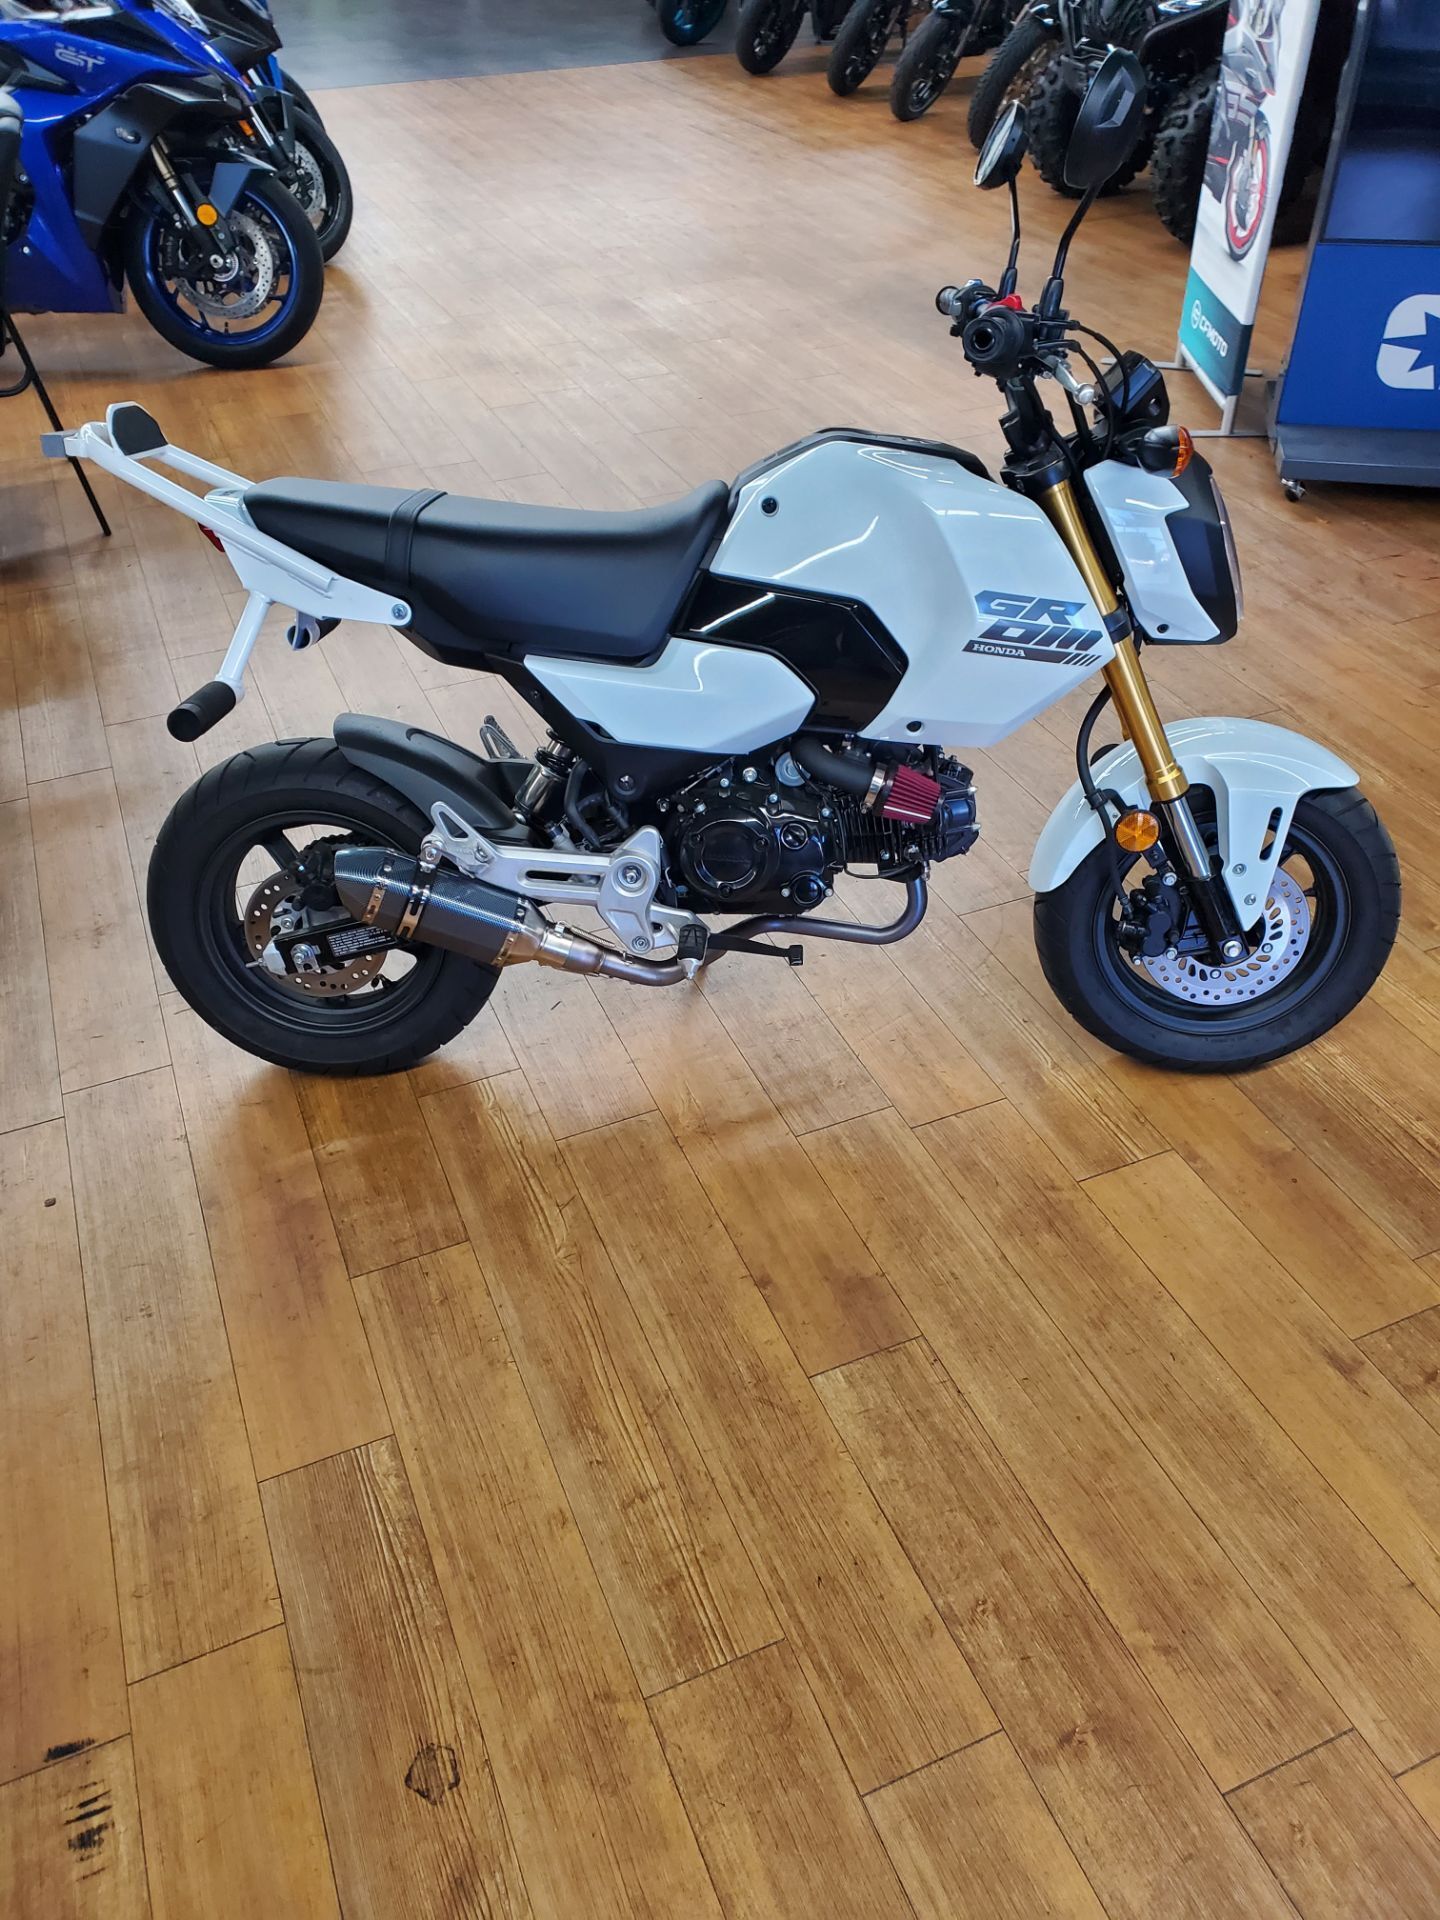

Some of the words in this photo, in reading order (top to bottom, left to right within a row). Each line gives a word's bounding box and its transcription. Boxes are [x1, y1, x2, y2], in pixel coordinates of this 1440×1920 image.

[55, 48, 105, 72] GT
[974, 590, 1087, 625] GR
[972, 643, 1026, 657] HONDA
